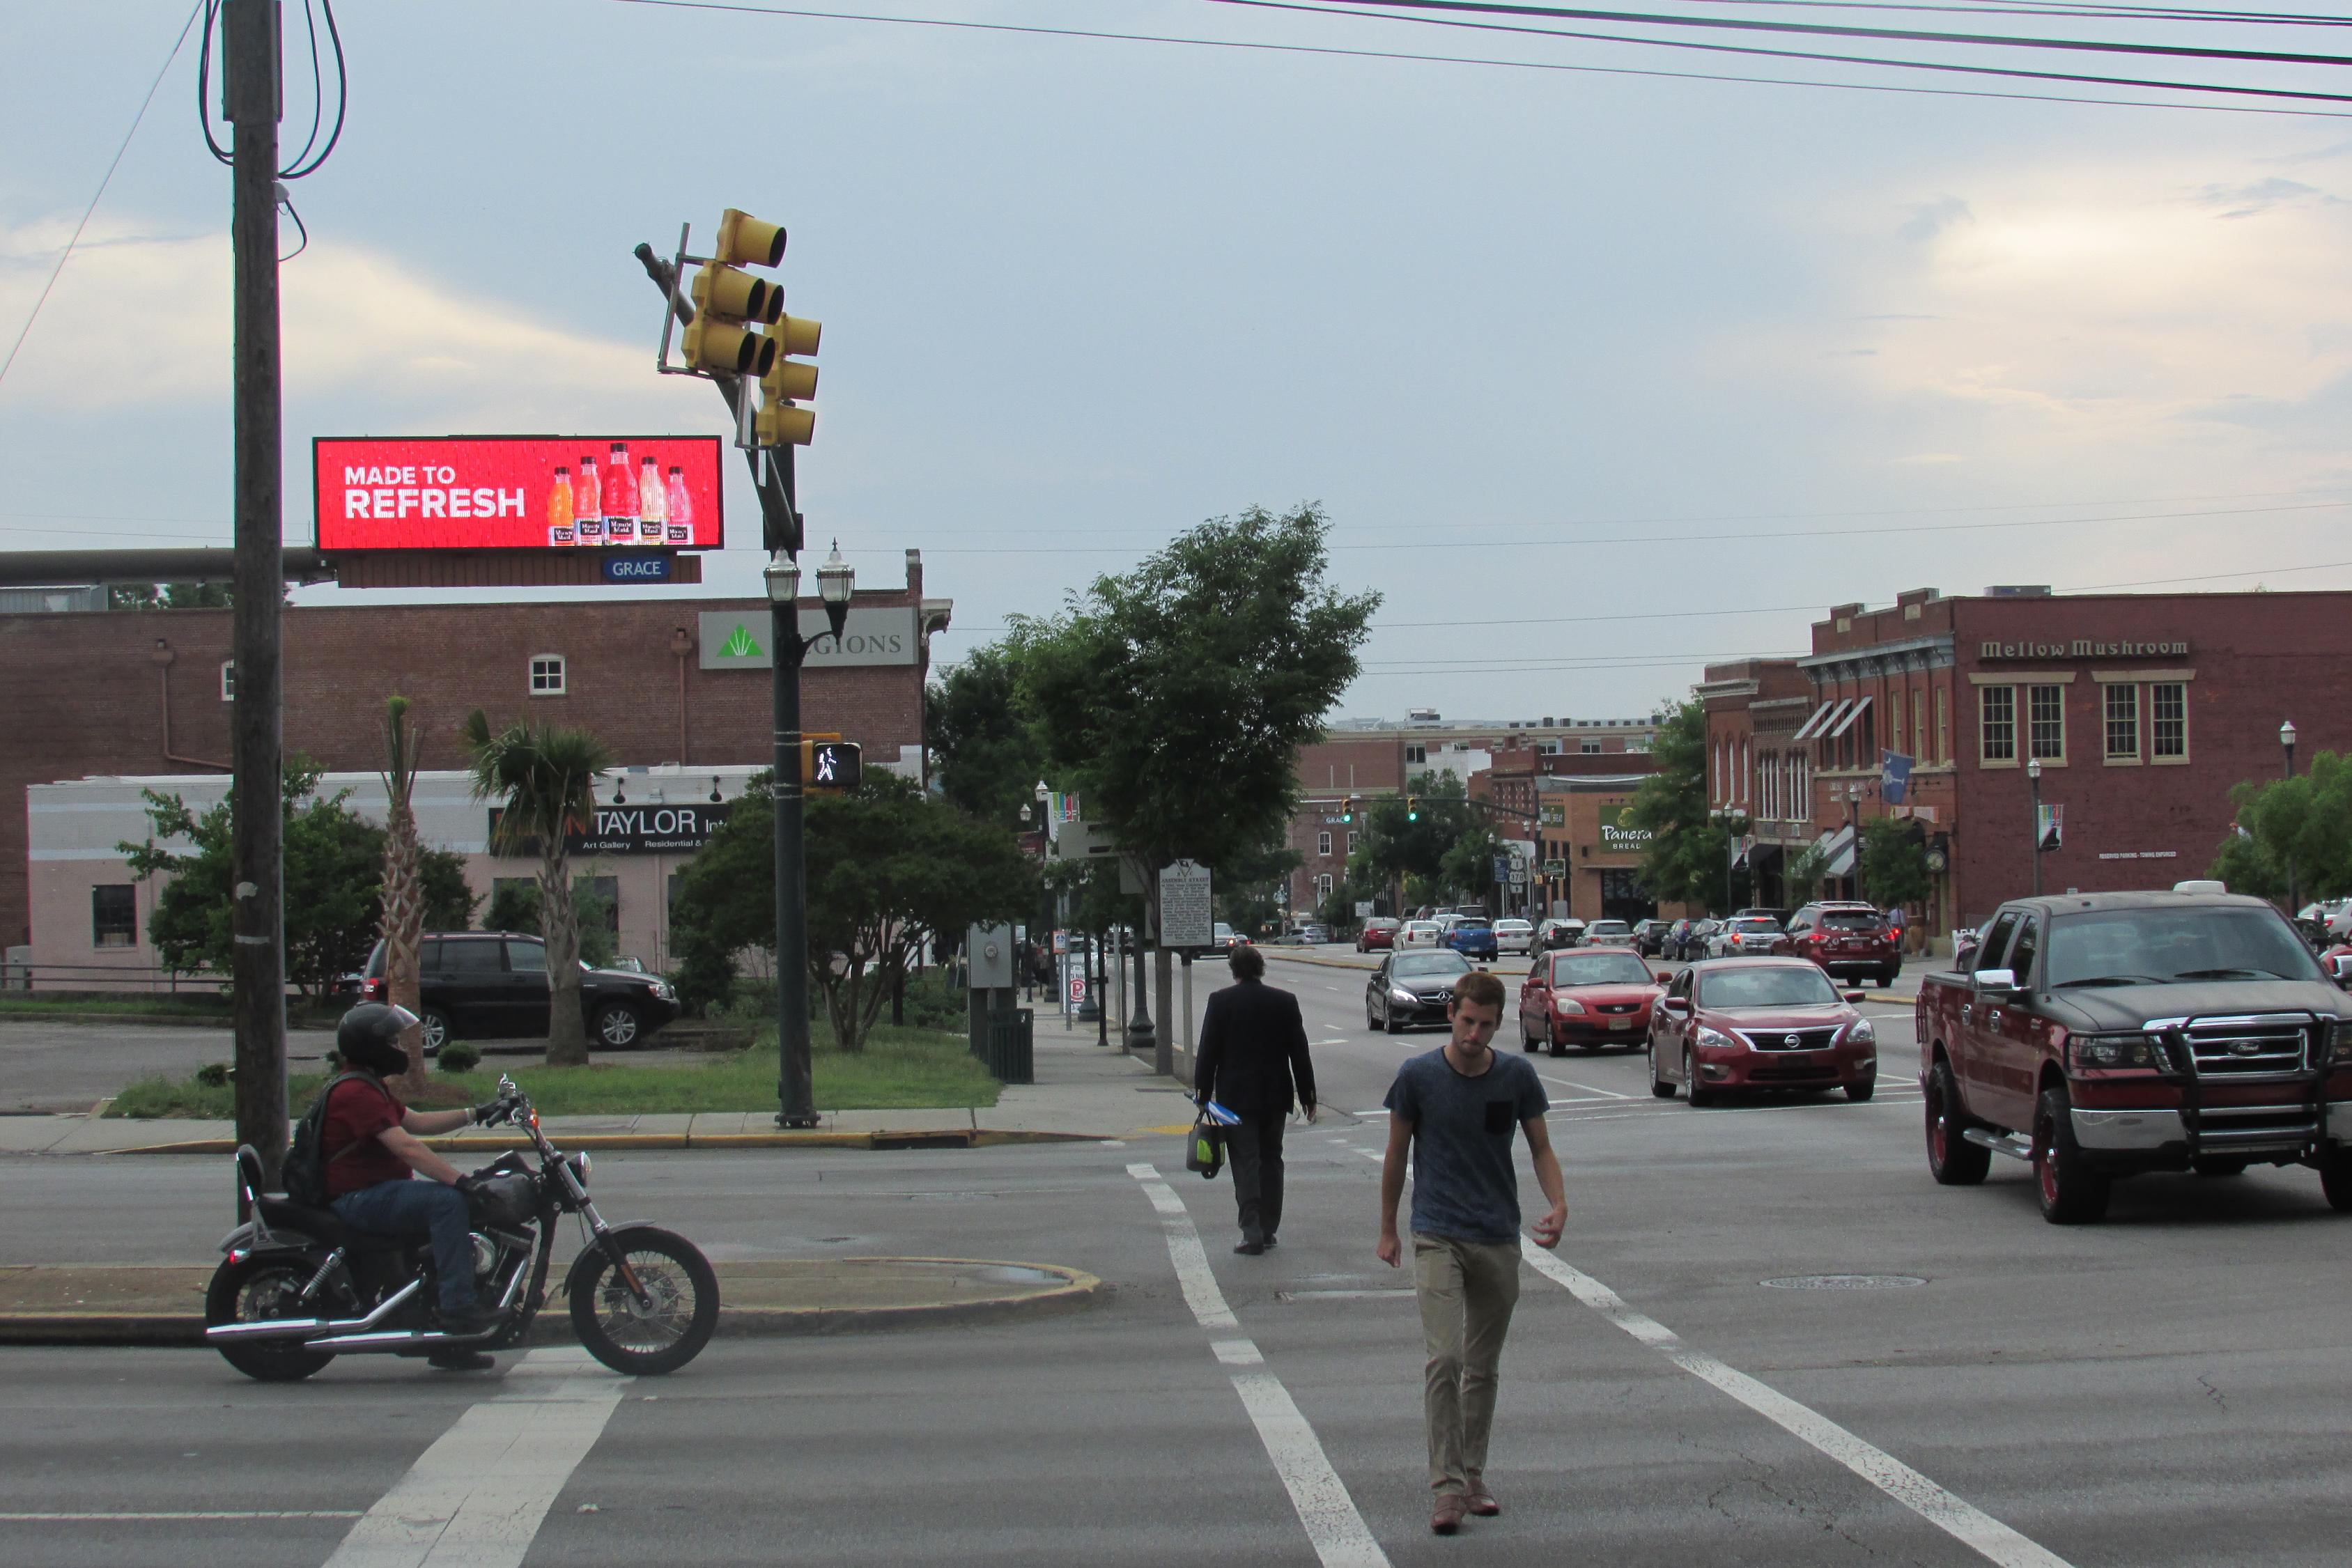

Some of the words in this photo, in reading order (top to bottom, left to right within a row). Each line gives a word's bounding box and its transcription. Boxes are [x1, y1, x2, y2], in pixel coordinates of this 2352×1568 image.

[345, 466, 417, 486] MADE
[422, 465, 456, 485] TO
[345, 488, 525, 519] REFRESH
[612, 561, 661, 577] GRACE
[802, 635, 902, 655] GIONS
[1981, 641, 2065, 658] Mellow
[2071, 639, 2188, 656] Mushroom
[595, 809, 697, 835] TAYLOR
[706, 818, 727, 833] Int
[1601, 825, 1653, 841] Panera
[599, 840, 631, 851] Gallery
[644, 839, 693, 848] Residential
